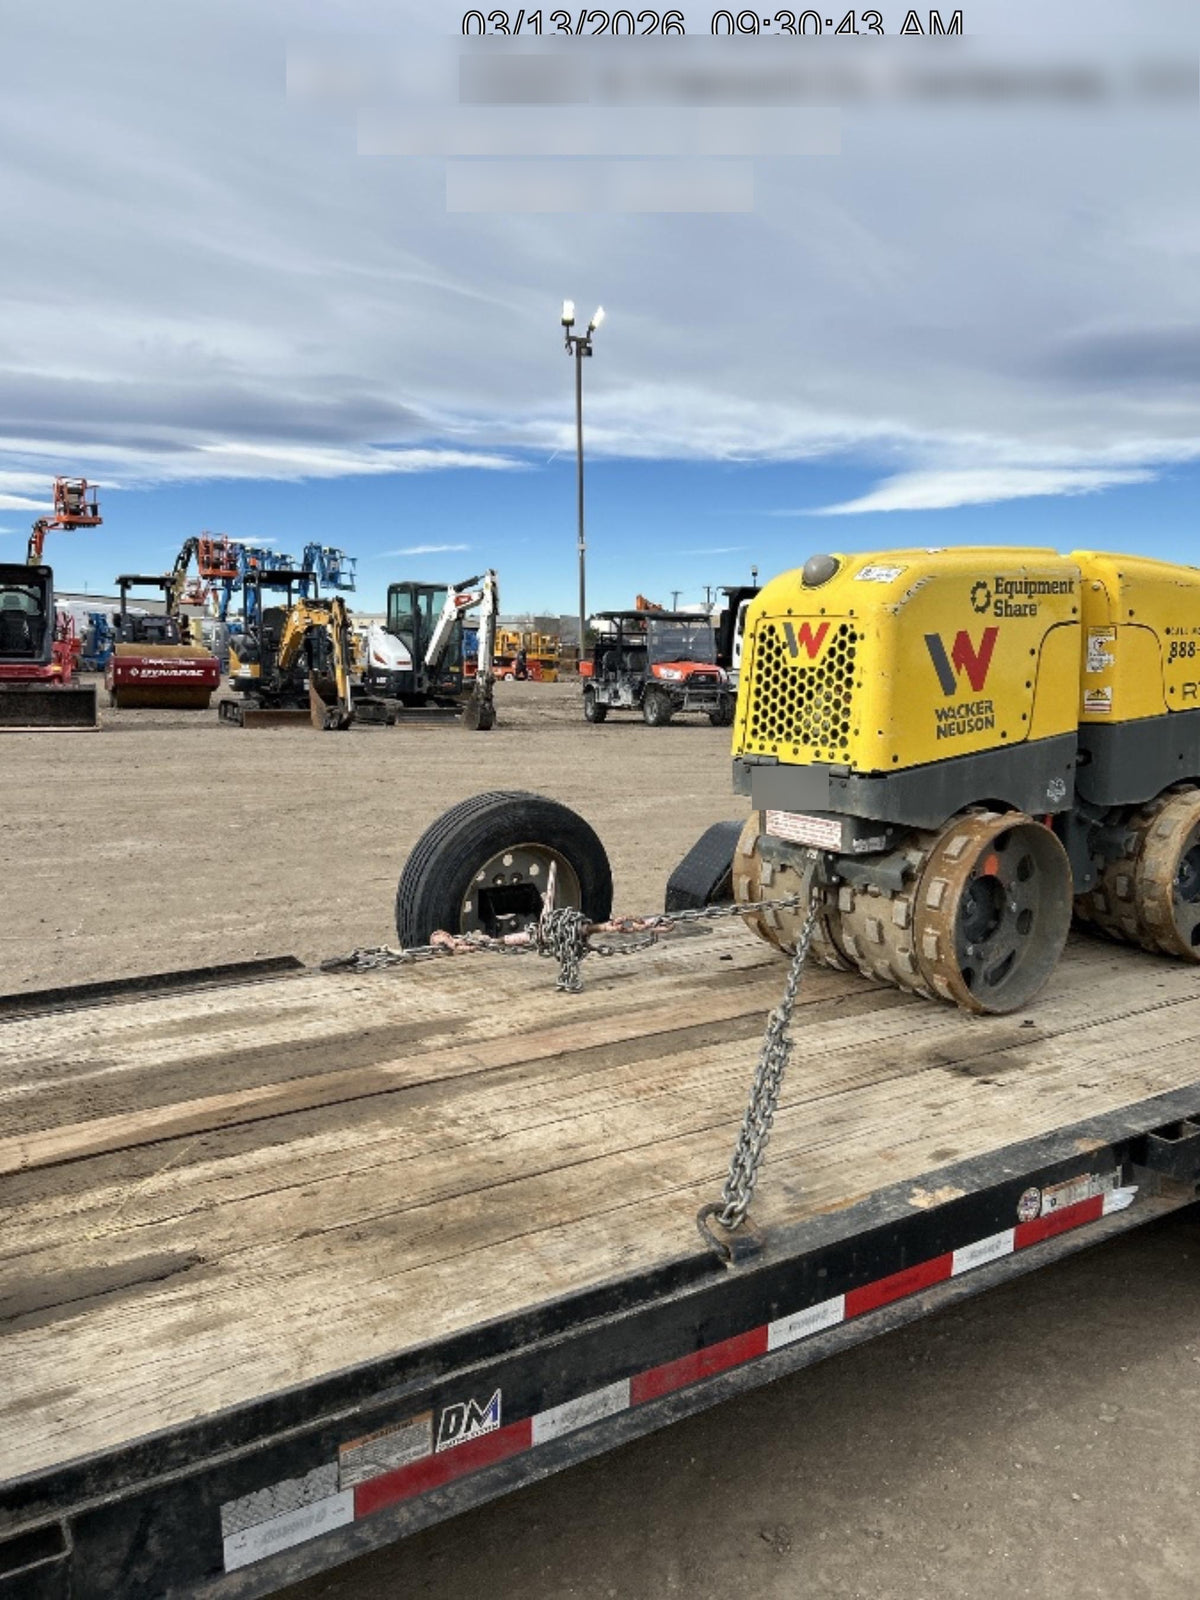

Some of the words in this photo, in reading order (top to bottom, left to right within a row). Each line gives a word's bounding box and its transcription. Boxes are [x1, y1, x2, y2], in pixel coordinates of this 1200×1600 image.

[994, 577, 1074, 599] Equipment
[993, 599, 1037, 617] Share
[1182, 681, 1200, 701] R
[935, 700, 994, 722] WACKER
[936, 715, 995, 740] NEUSON
